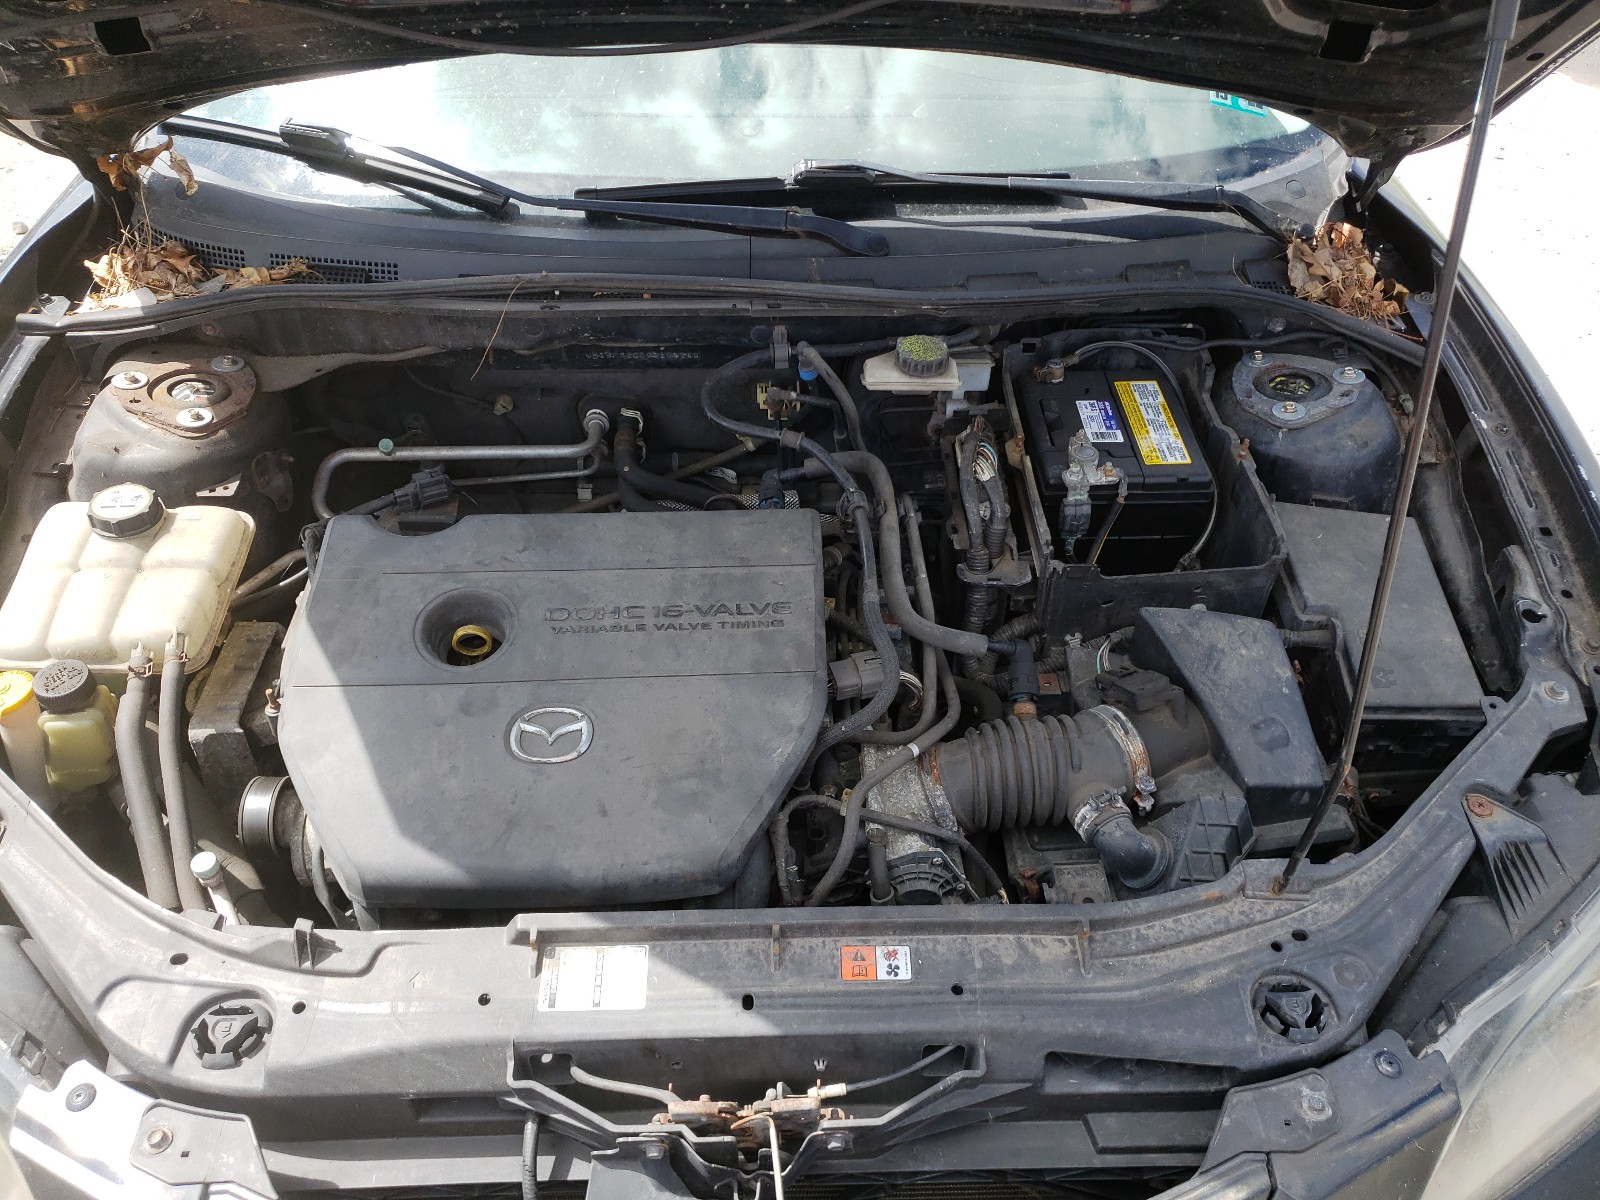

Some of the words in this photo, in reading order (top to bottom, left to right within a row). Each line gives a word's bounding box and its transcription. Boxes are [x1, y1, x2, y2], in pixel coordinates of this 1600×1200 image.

[544, 605, 645, 622] DOHC
[652, 601, 793, 620] 16-VALVE
[550, 623, 648, 635] VARIABLE
[653, 622, 713, 632] VALVE
[717, 619, 785, 630] TIMING
